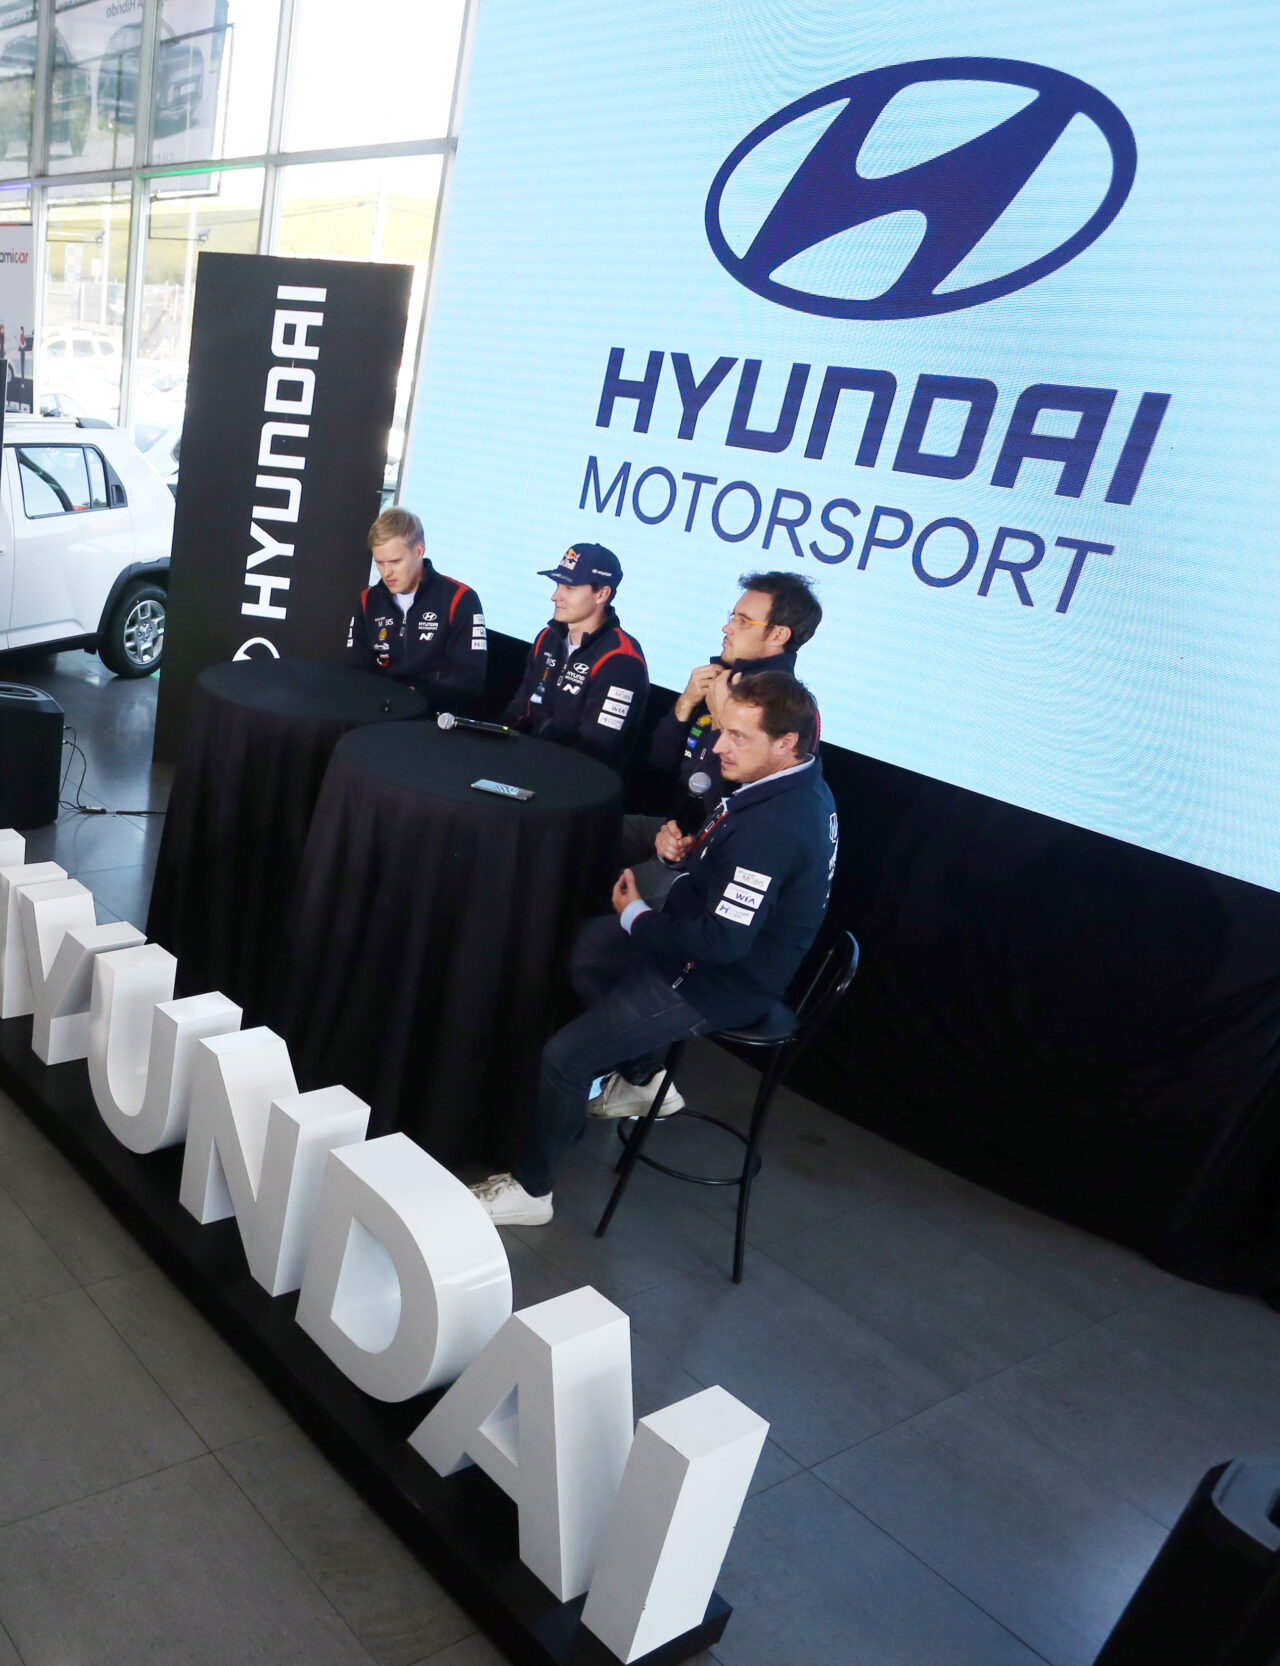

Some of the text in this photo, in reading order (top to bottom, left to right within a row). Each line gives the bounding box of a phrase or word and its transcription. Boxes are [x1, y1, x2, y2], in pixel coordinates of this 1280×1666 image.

[241, 285, 327, 620] HYUNDAI
[595, 346, 1173, 506] HYUNDAI
[578, 456, 1116, 614] MOTORSPORT
[567, 670, 585, 680] HYUND
[735, 892, 756, 905] WIA
